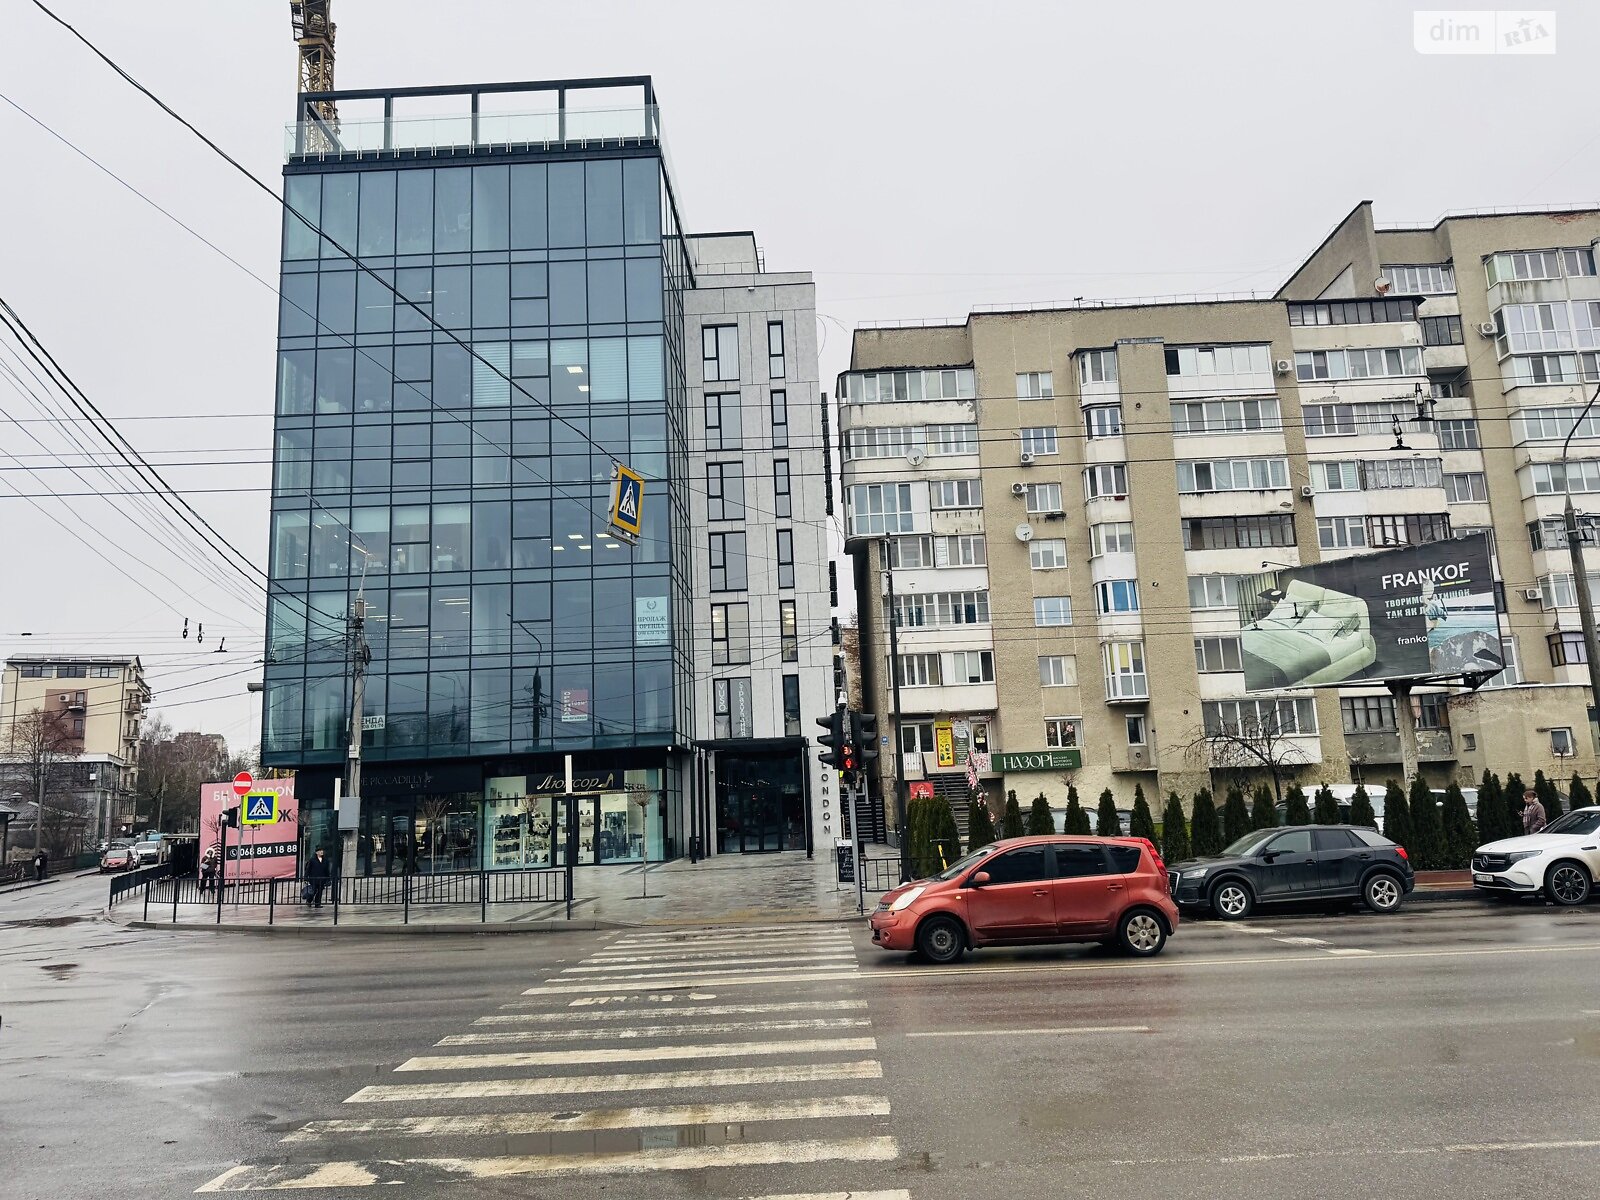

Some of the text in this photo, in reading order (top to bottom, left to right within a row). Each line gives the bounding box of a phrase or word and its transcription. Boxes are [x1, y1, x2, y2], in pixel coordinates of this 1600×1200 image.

[1381, 562, 1470, 590] FRANKOF
[718, 682, 726, 712] VUSO
[821, 761, 832, 835] LONDON
[256, 846, 272, 855] 884
[275, 846, 285, 854] 18
[286, 844, 298, 853] 88
